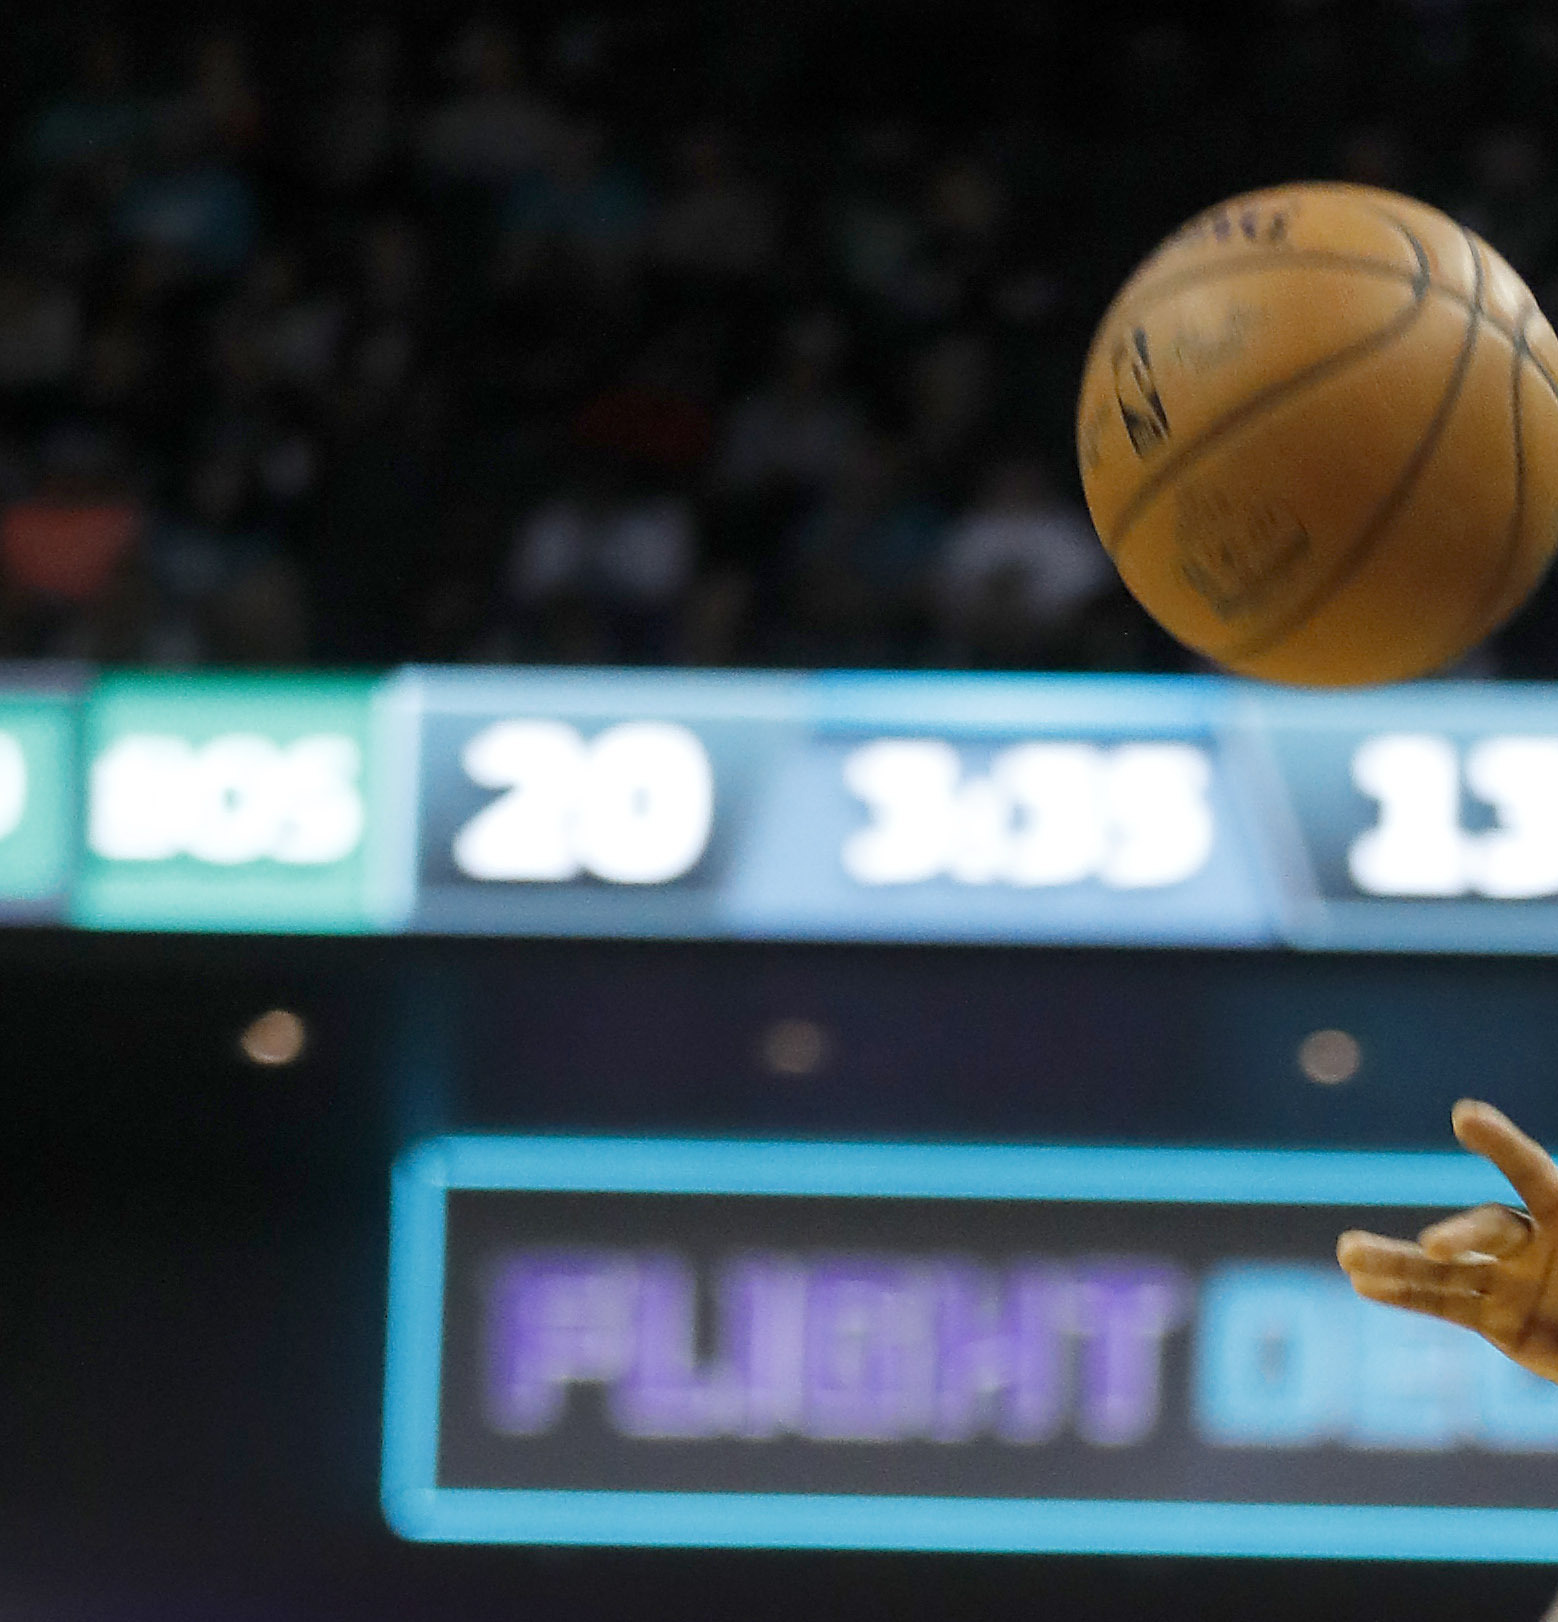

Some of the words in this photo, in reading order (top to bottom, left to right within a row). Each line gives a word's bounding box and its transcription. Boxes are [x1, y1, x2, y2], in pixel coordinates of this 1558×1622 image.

[91, 733, 365, 863] BOS
[456, 719, 713, 882] 20
[487, 1252, 1186, 1444] FLIGHT
